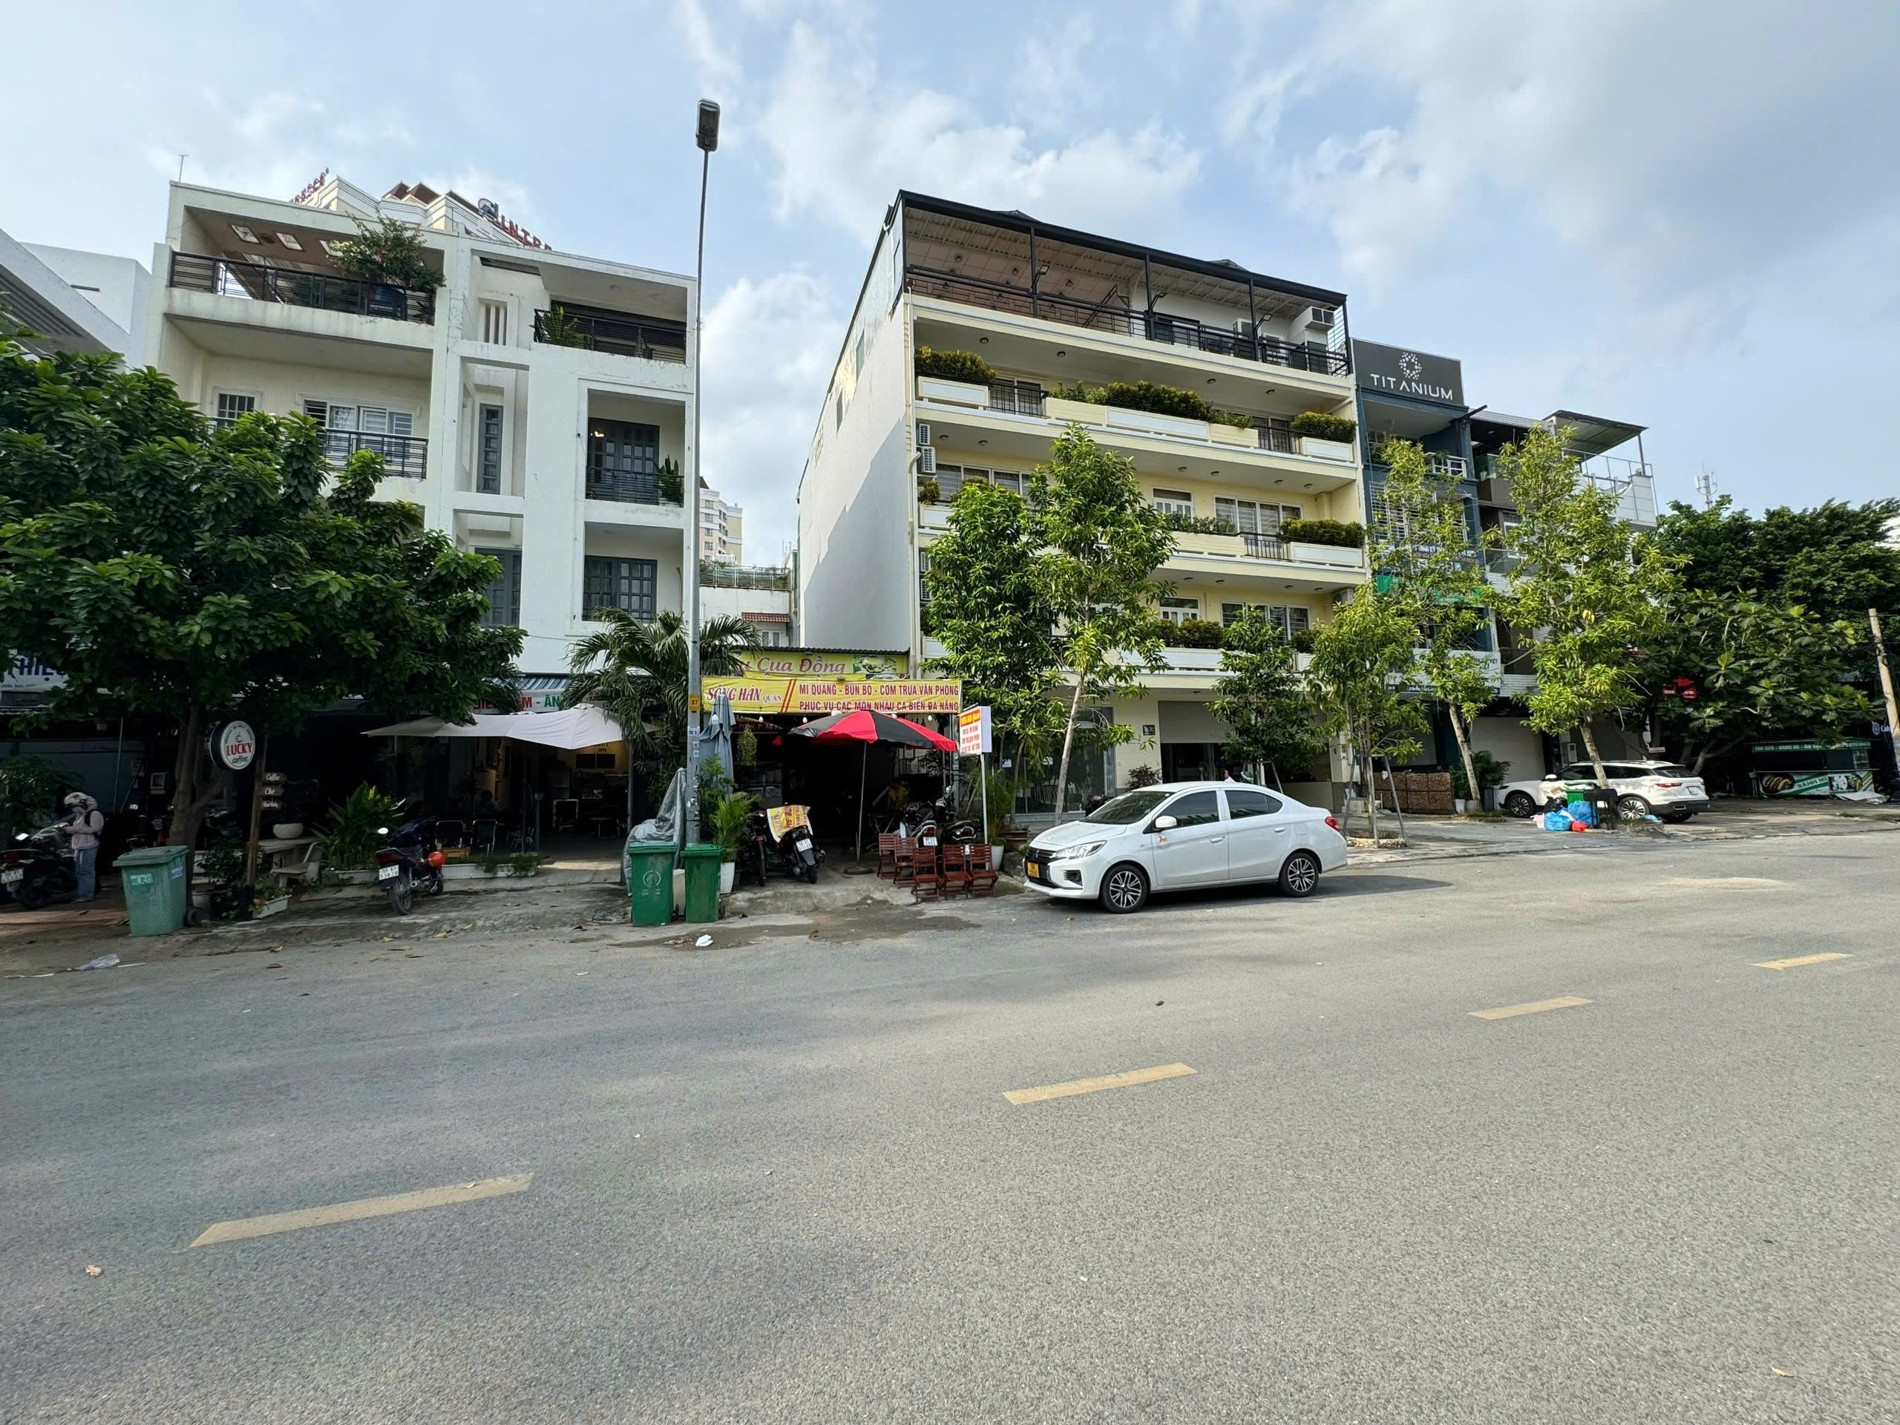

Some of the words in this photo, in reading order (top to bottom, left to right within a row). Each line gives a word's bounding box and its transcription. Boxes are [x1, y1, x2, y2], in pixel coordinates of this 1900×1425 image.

[1370, 373, 1454, 401] TITANIUM
[798, 655, 846, 674] Đồng
[226, 742, 253, 756] LUCKY
